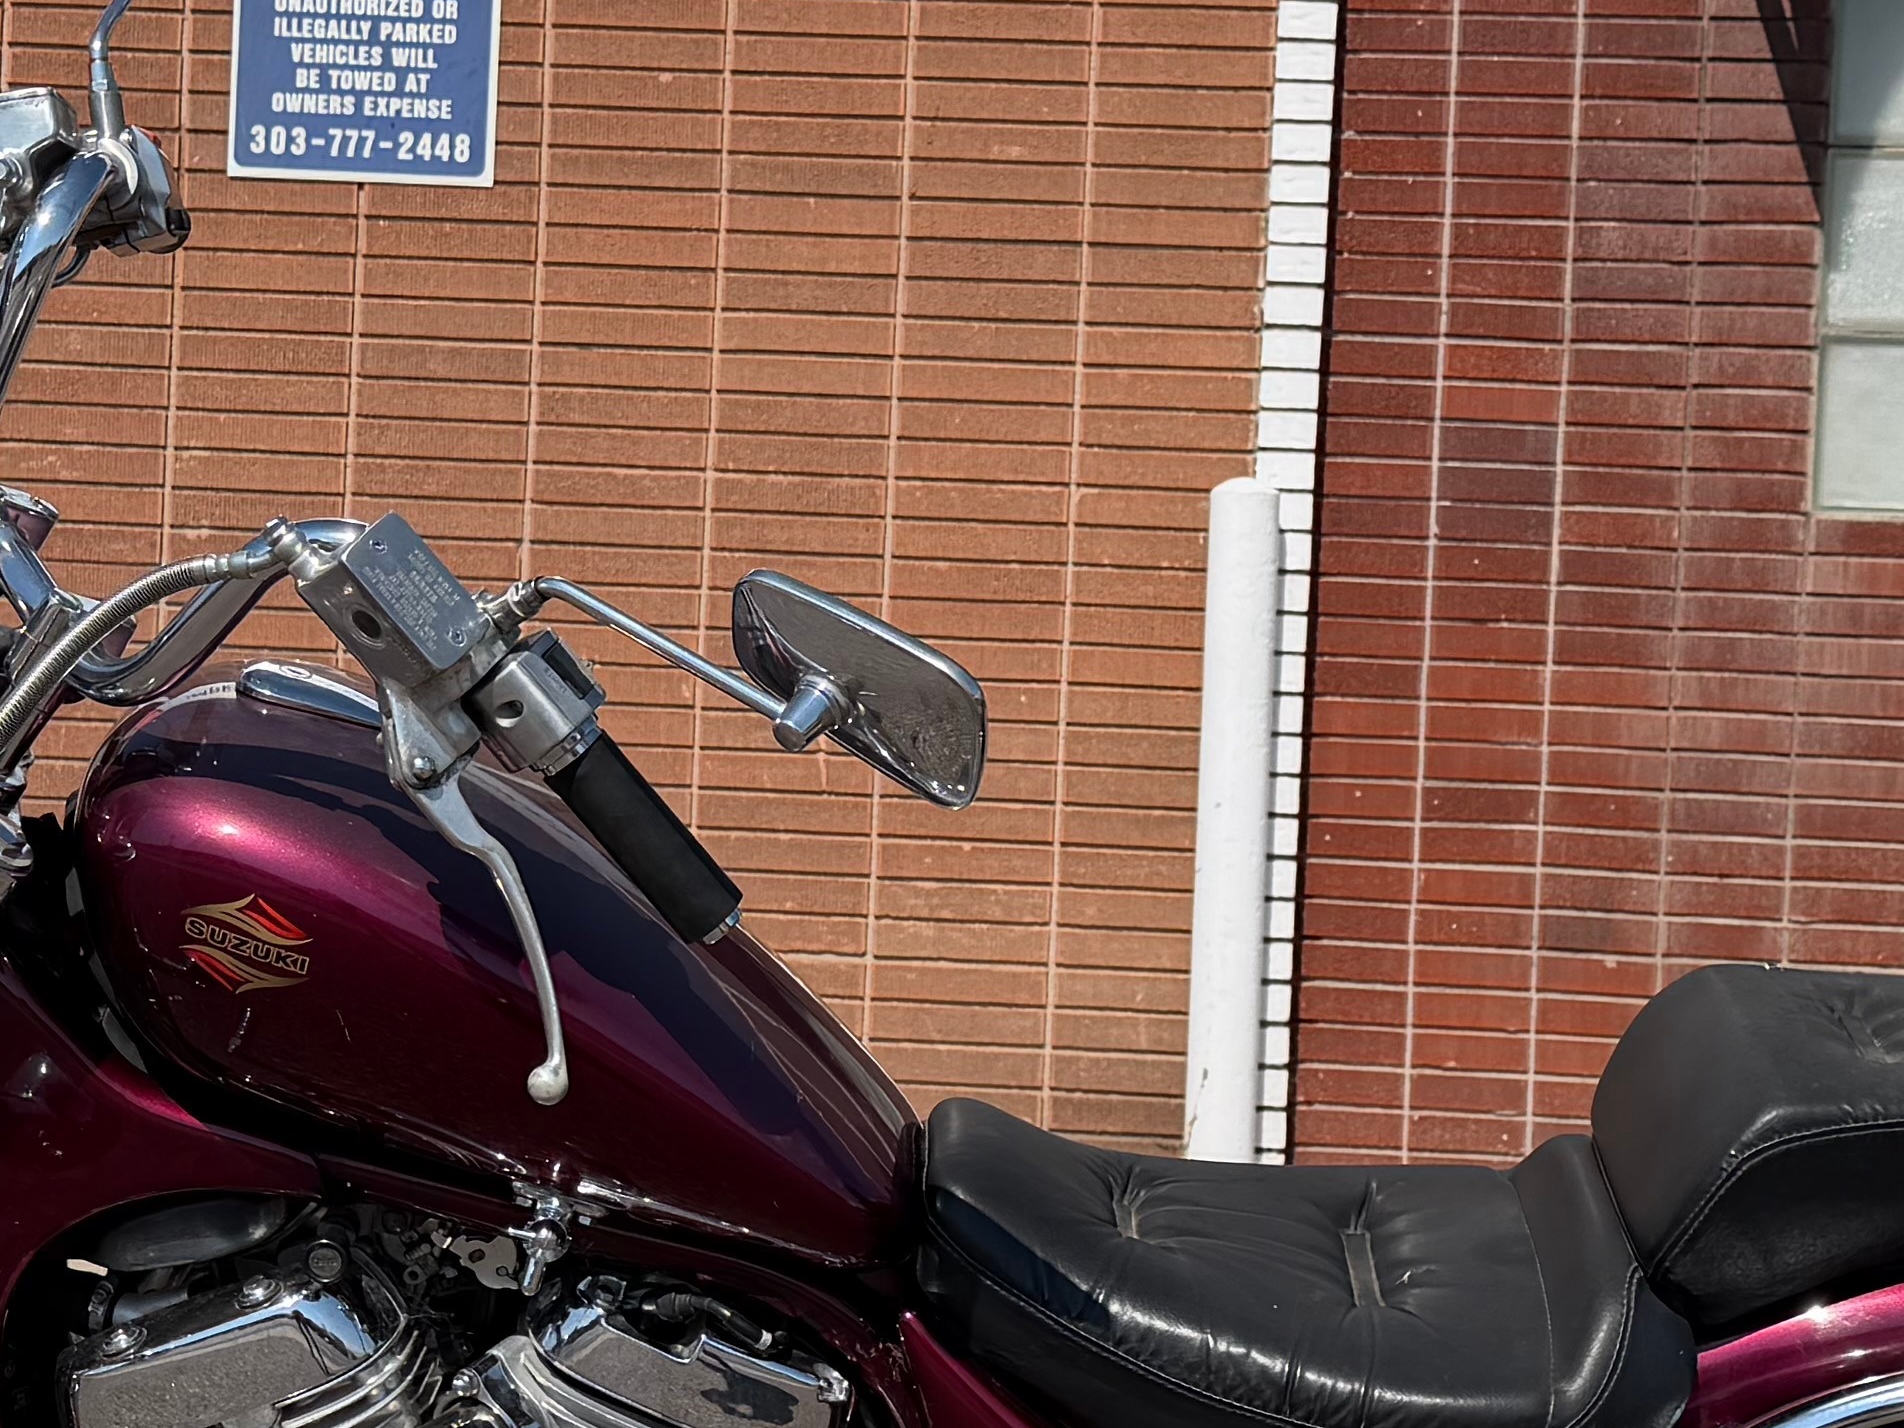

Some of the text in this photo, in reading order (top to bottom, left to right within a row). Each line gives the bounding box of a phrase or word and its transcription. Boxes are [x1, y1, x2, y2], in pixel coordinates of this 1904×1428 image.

[273, 16, 457, 44] ILLEGALLY PARKED
[290, 42, 438, 69] VEHICLES WILL
[295, 68, 431, 94] BE TOWED AT
[271, 91, 452, 120] OWNERS EXPENSE
[249, 124, 471, 163] 303-777-2448
[185, 917, 310, 975] SUZUKI
